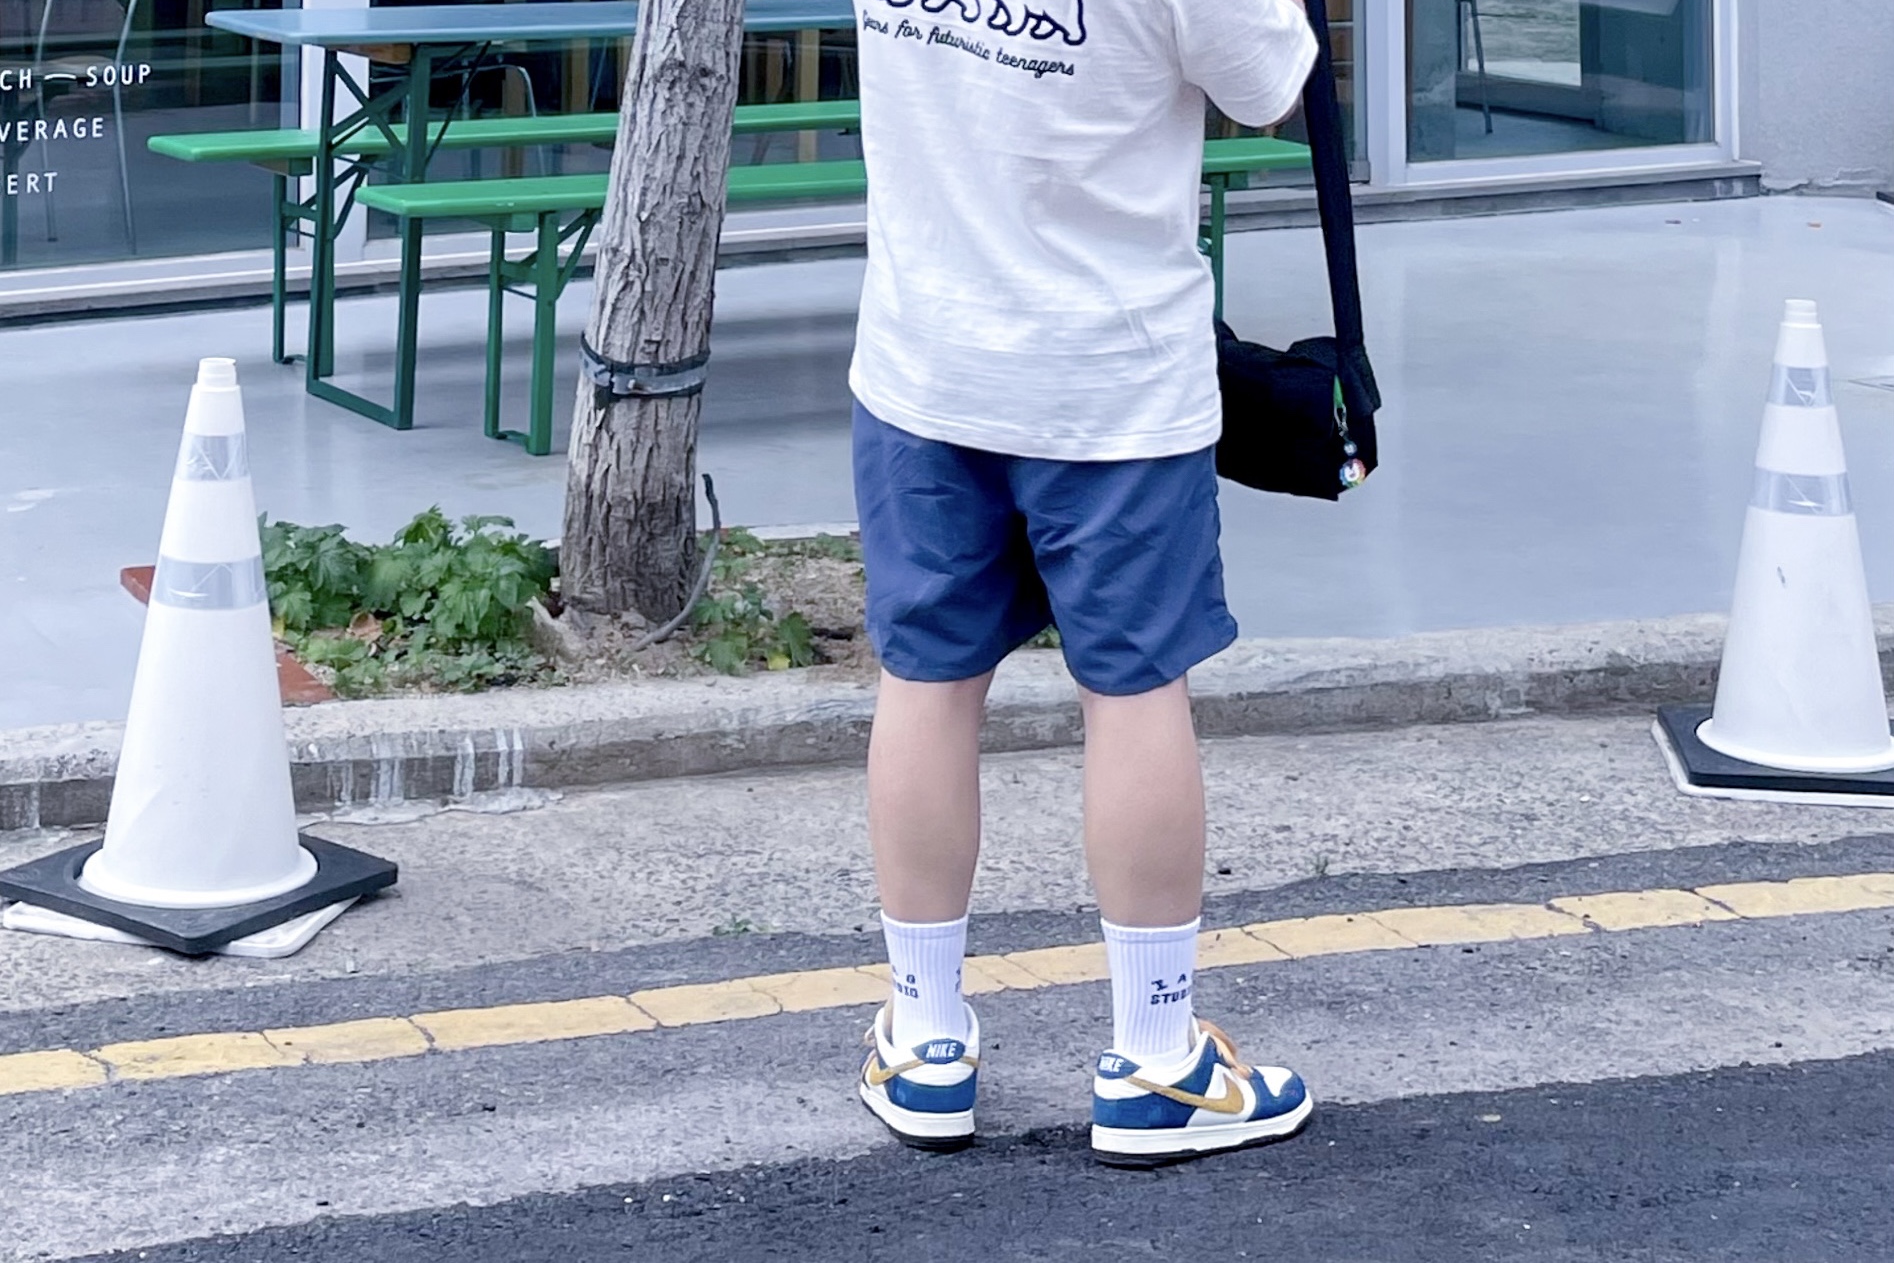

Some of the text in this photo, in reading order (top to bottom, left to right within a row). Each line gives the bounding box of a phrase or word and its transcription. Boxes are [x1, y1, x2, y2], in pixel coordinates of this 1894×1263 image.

[895, 19, 923, 40] for
[926, 26, 990, 60] futuristic
[996, 47, 1075, 78] teenagers
[86, 64, 151, 87] SOUP
[0, 117, 104, 142] VERAGE
[7, 172, 58, 195] ERT
[925, 1042, 957, 1059] NIKE
